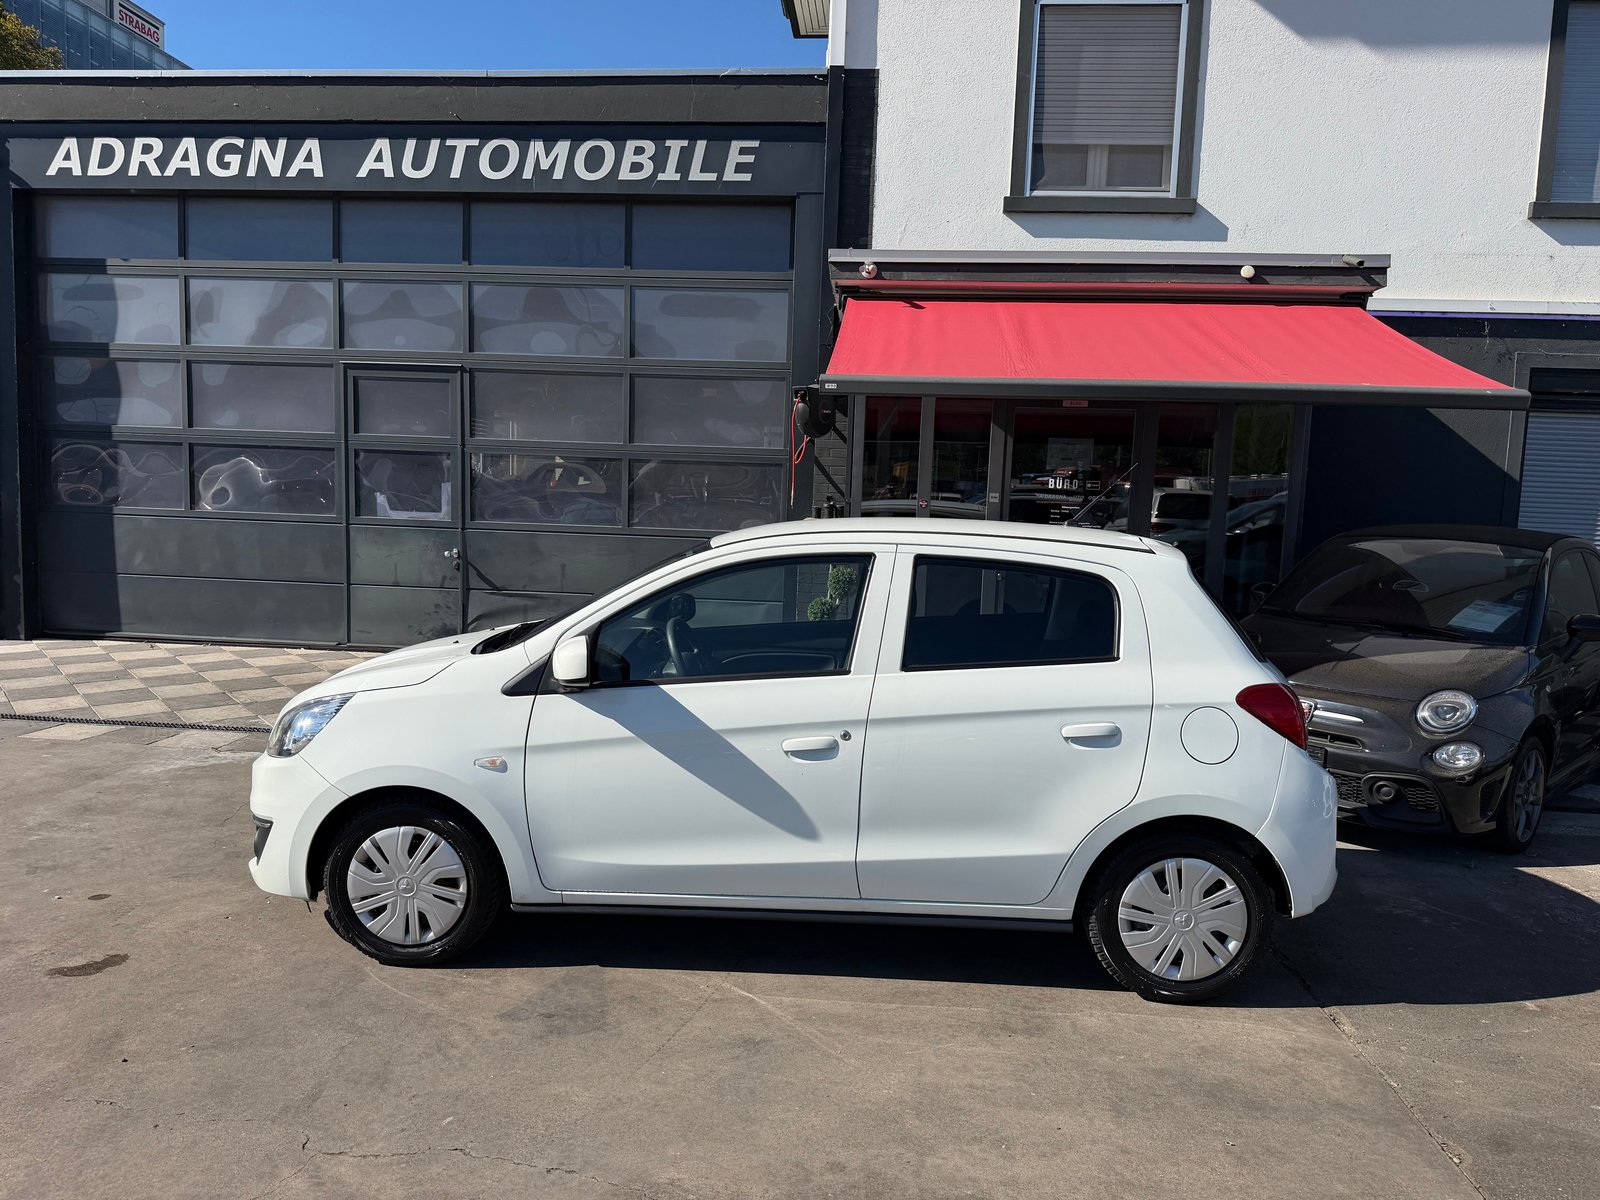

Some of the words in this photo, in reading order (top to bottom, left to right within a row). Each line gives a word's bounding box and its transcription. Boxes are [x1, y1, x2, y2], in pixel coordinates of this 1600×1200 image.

[119, 9, 160, 42] STRABAG
[45, 136, 325, 178] ADRAGNA
[355, 137, 761, 182] AUTOMOBILE
[1048, 476, 1078, 489] BÜRO
